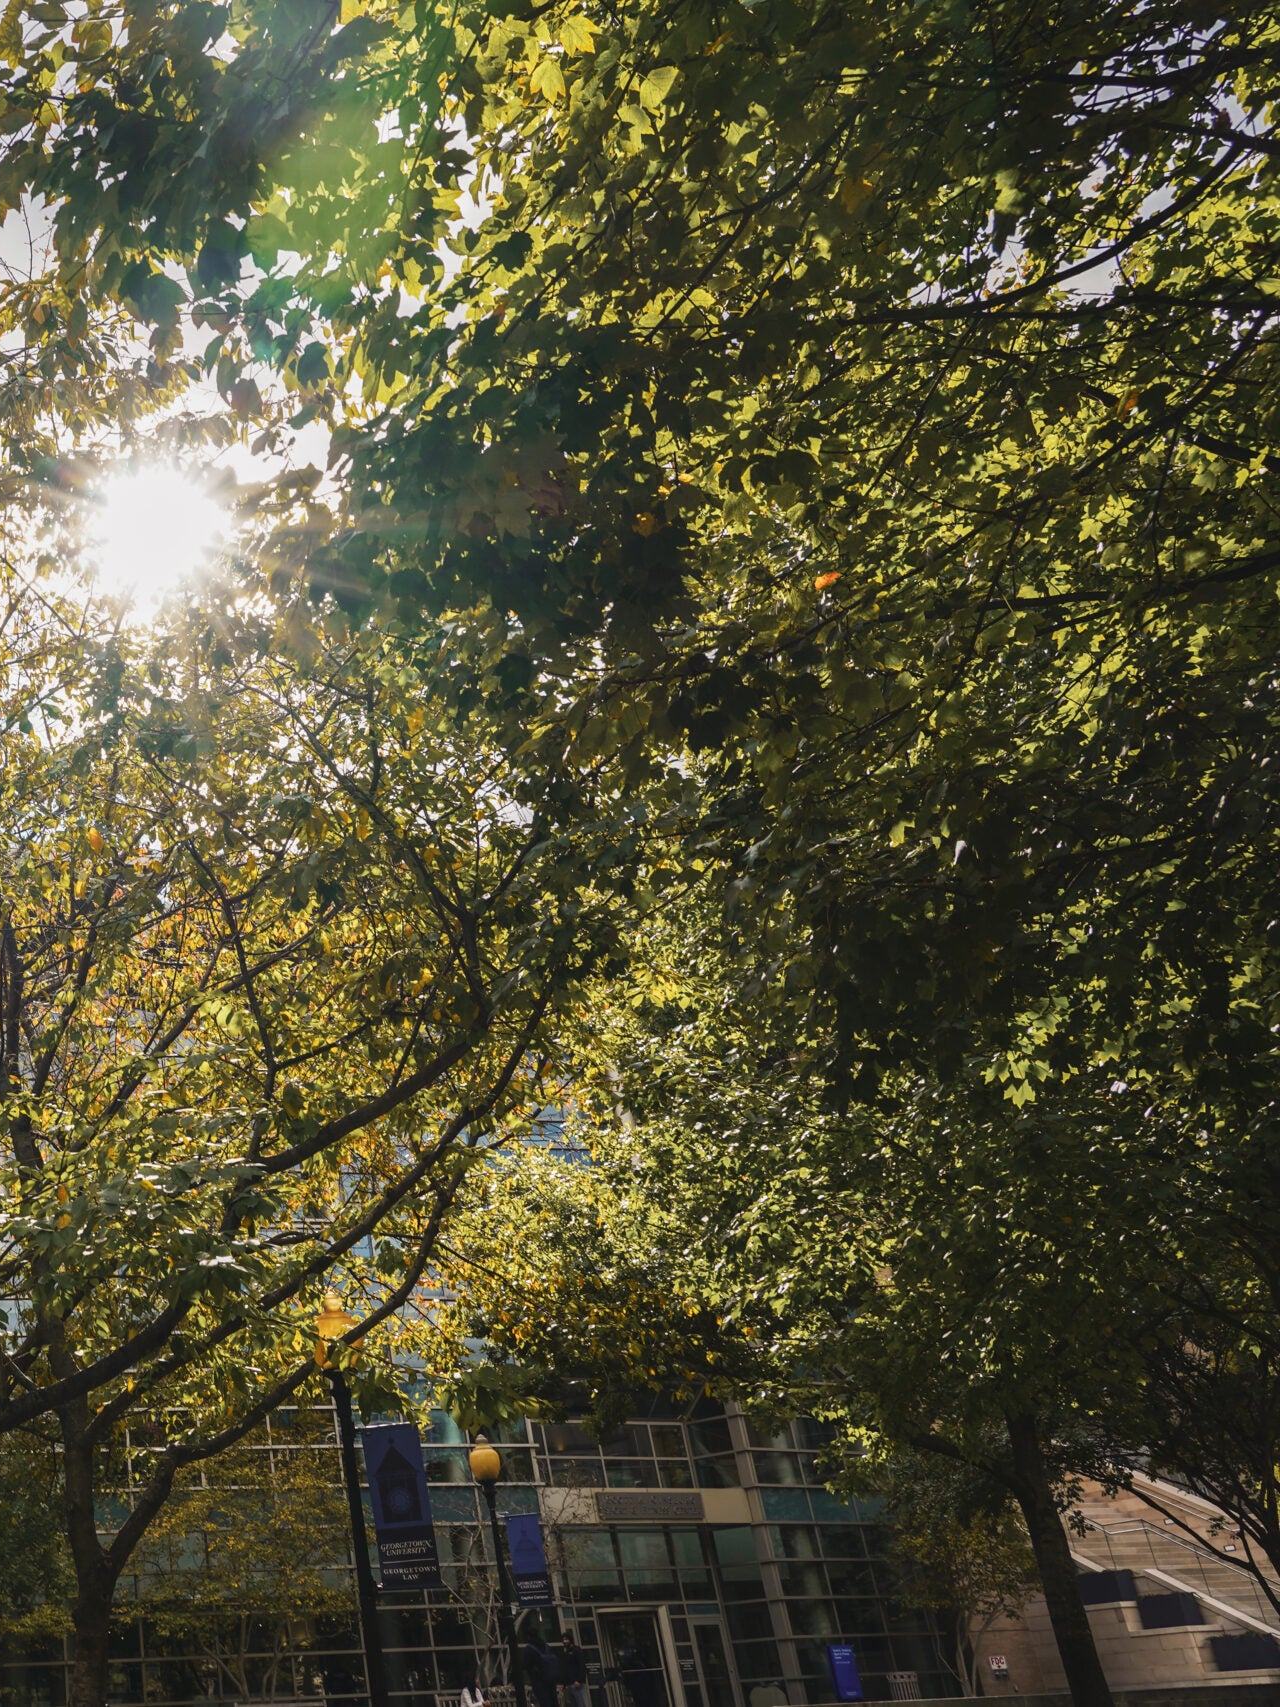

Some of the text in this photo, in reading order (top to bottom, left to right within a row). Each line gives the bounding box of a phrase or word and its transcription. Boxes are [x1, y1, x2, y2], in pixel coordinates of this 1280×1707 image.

[380, 1539, 433, 1553] GEORGETOWN
[386, 1547, 427, 1556] UNIVERSITY
[383, 1565, 437, 1575] GEORGETOWN
[991, 1656, 1005, 1665] FDC
